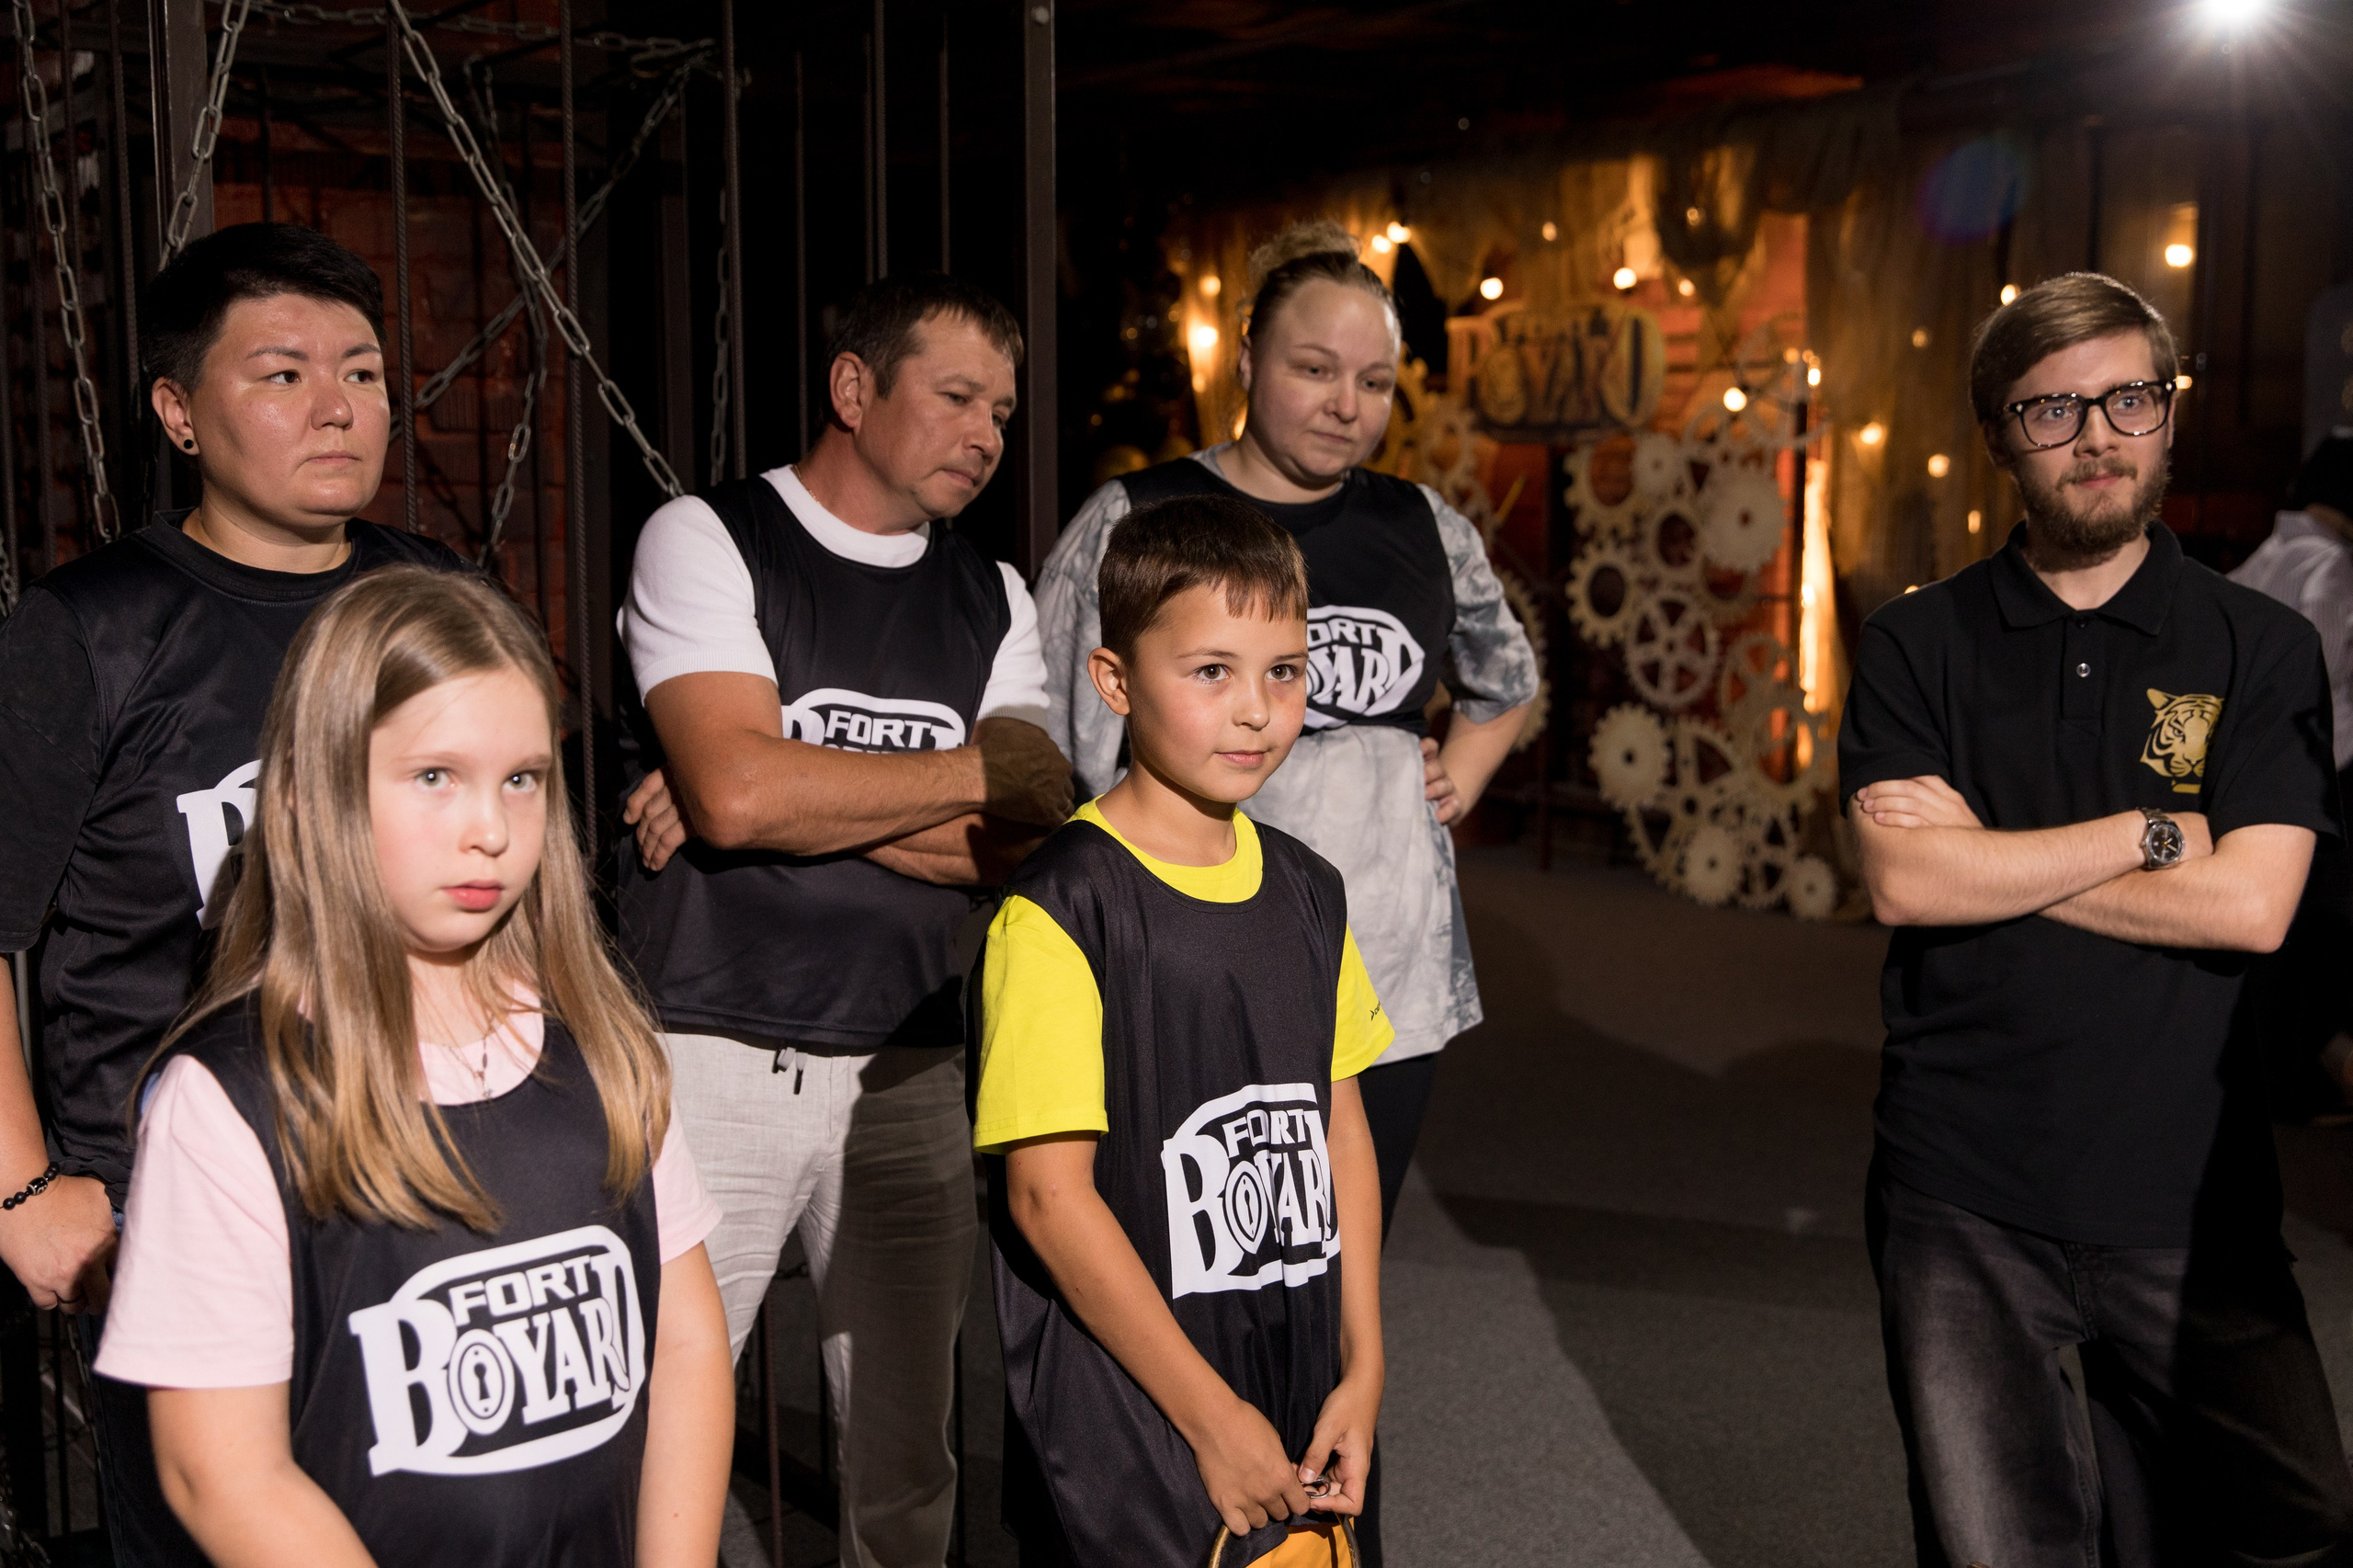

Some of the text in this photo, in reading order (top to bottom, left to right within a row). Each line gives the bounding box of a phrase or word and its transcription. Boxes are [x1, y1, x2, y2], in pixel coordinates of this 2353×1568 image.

[1306, 618, 1377, 651] ORT
[1306, 626, 1425, 715] YARD
[824, 710, 932, 749] FORT
[1222, 1108, 1307, 1158] FORT
[449, 1255, 590, 1327] FORT
[348, 1252, 644, 1477] BOYARD
